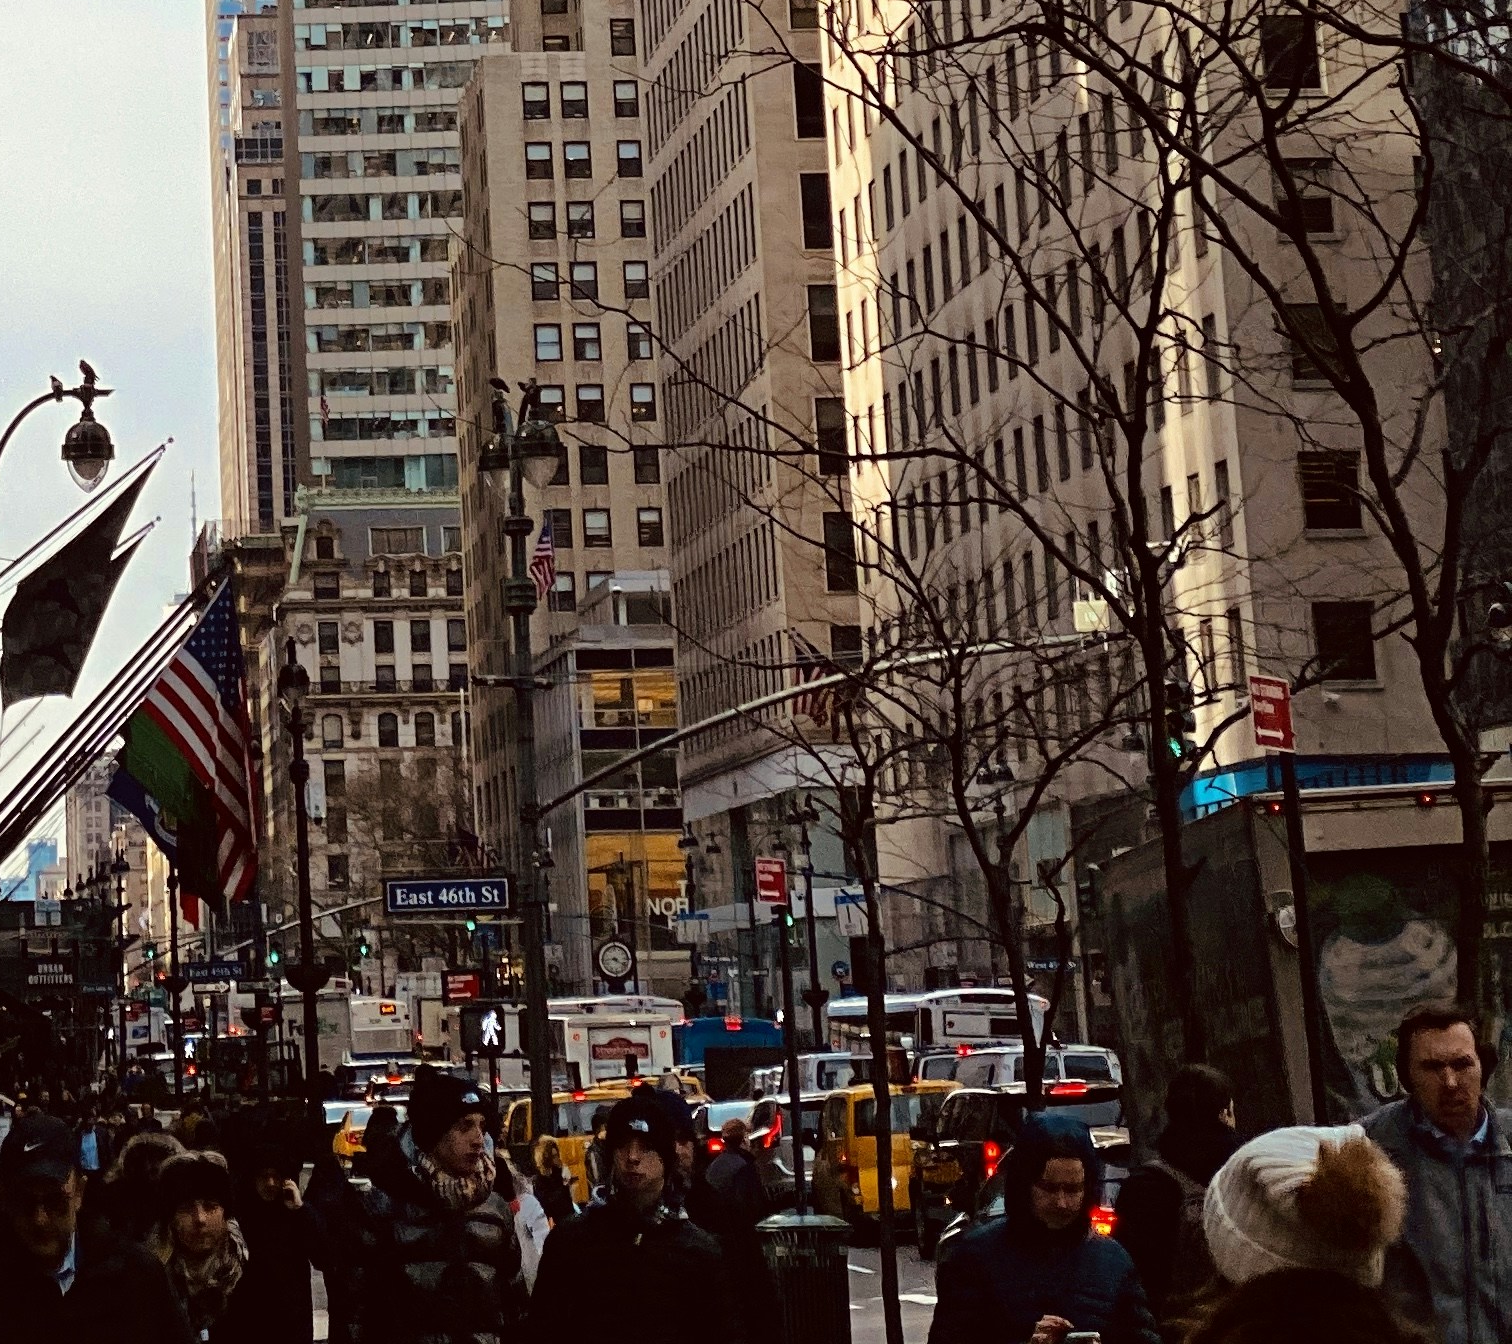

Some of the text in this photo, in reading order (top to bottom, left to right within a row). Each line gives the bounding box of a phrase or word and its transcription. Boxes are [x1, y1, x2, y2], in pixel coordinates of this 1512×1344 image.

[396, 885, 500, 906] East 46th St
[646, 897, 689, 916] NOR
[37, 963, 64, 974] URBAN
[27, 974, 73, 985] OUTFITTERS
